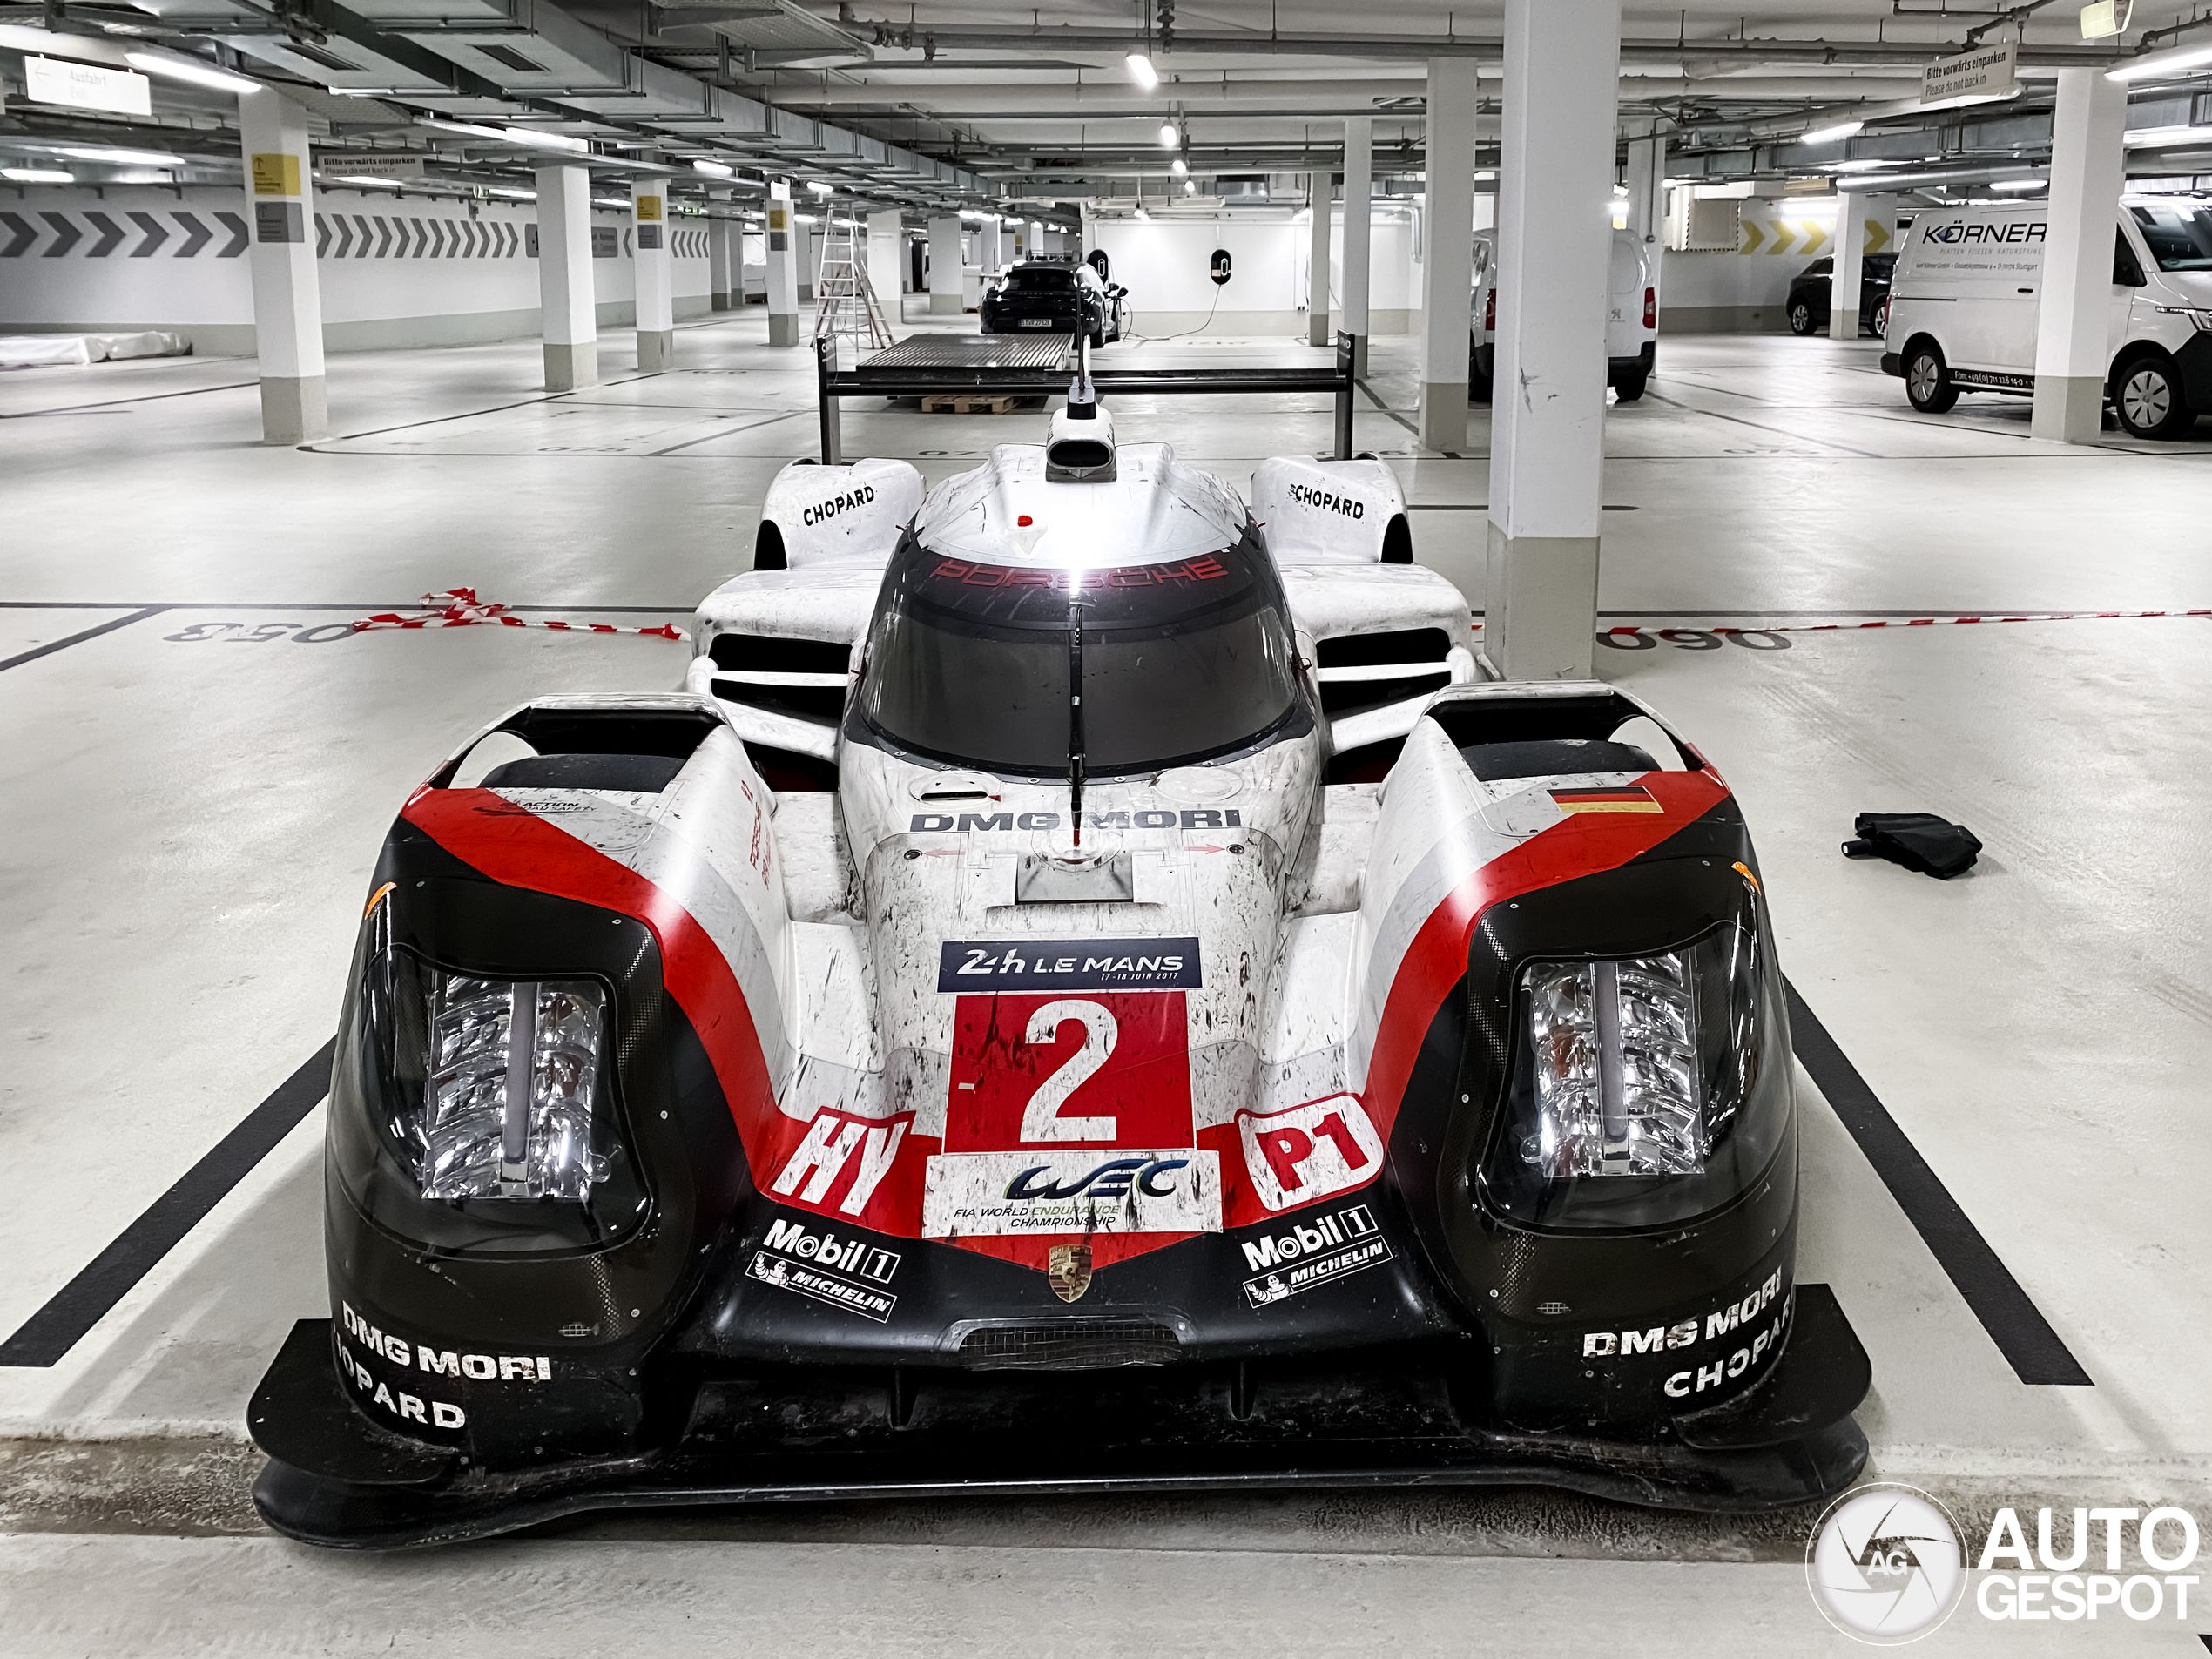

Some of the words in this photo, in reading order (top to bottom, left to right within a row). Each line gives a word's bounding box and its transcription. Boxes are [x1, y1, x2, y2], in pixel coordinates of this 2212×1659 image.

[1925, 84, 1945, 97] Please
[1945, 80, 1953, 93] do
[1953, 77, 1964, 91] not
[1965, 75, 1979, 88] back
[1979, 72, 1986, 84] in
[1926, 66, 1942, 80] Bitte
[1943, 58, 1971, 76] vorwärts
[1972, 51, 2006, 70] einparken
[378, 157, 416, 165] einparken
[1922, 219, 2047, 244] KÖRNER
[803, 486, 874, 527] CHOPARD
[1295, 484, 1364, 520] CHOPARD
[929, 556, 1228, 589] PORSCHE
[909, 812, 1061, 833] DMG
[1081, 809, 1242, 830] MORI
[956, 948, 1026, 974] 24h
[1033, 957, 1077, 973] LE
[1082, 956, 1184, 973] MANS
[1020, 999, 1118, 1143] 2
[771, 1114, 909, 1217] HY
[1255, 1111, 1370, 1192] P1
[1003, 1158, 1189, 1200] WEC
[954, 1208, 976, 1218] FIA
[981, 1207, 1028, 1217] WORLD
[1031, 1204, 1121, 1216] ENDURANCE
[1010, 1217, 1116, 1228] CHAMPIONSHIP
[762, 1218, 867, 1272] Mobil
[873, 1254, 890, 1278] 1
[1241, 1215, 1344, 1271] Mobil
[1348, 1210, 1367, 1232] 1
[1291, 1241, 1384, 1285] MICHELIN
[791, 1271, 891, 1312] MICHELIN
[1582, 1320, 1698, 1358] DMG
[1705, 1264, 1782, 1340] MORI
[342, 1299, 411, 1366] DMG
[417, 1345, 552, 1380] MORI
[1663, 1287, 1793, 1398] CHOPAR
